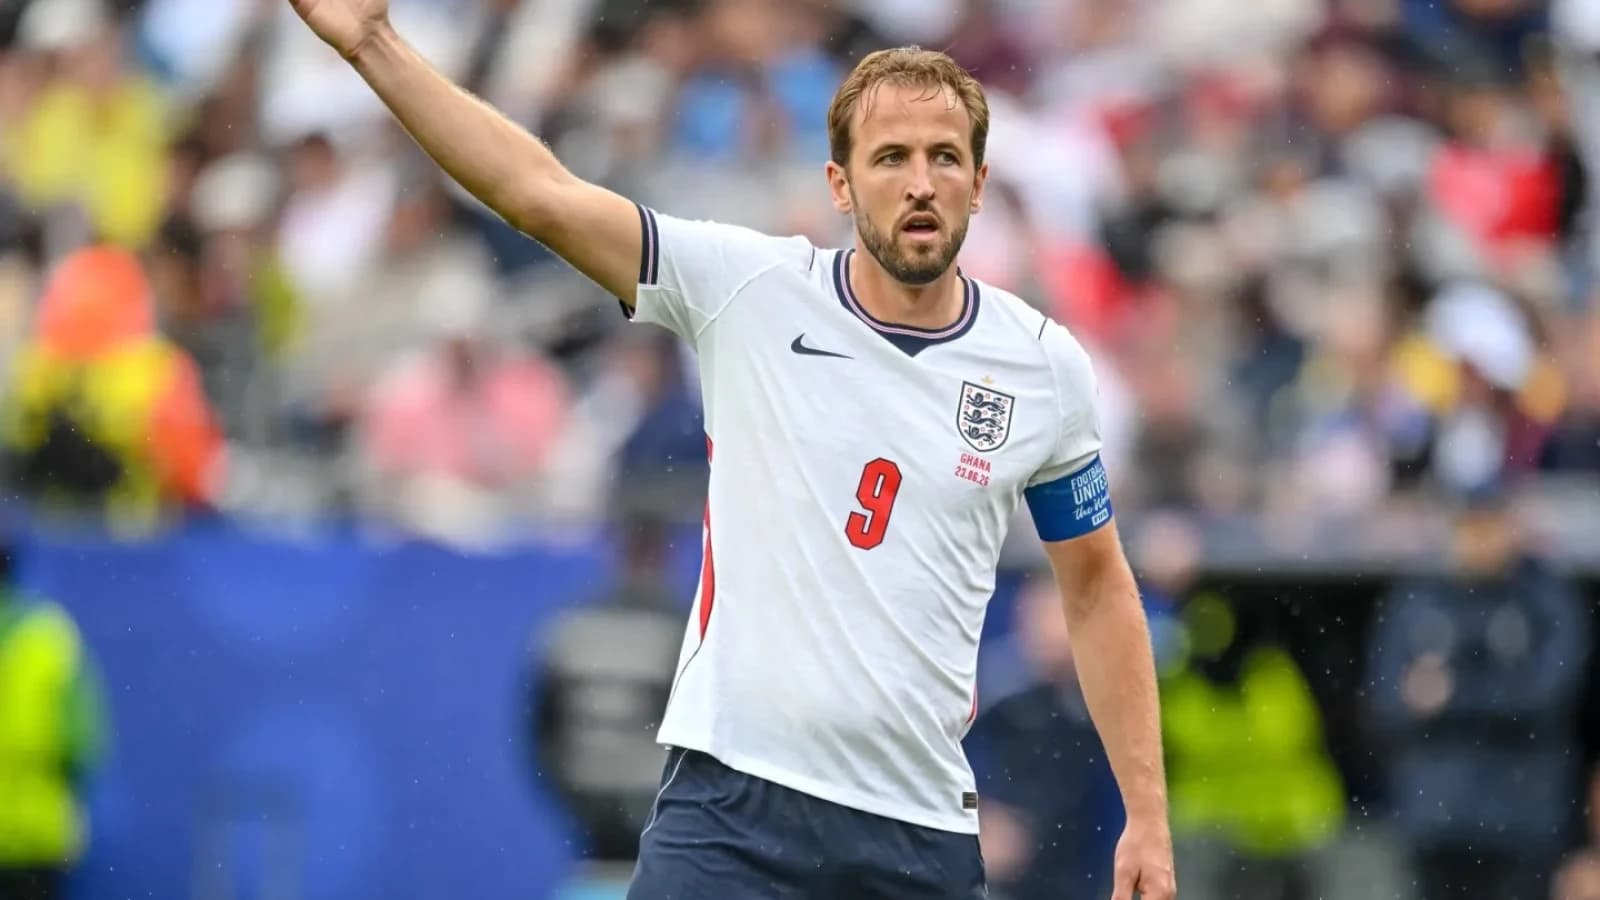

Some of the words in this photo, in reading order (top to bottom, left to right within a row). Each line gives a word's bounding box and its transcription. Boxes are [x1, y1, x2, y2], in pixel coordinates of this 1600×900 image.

[960, 452, 991, 473] GHANA
[954, 465, 990, 487] 23.06.26
[844, 457, 902, 550] 9
[1072, 504, 1093, 521] the
